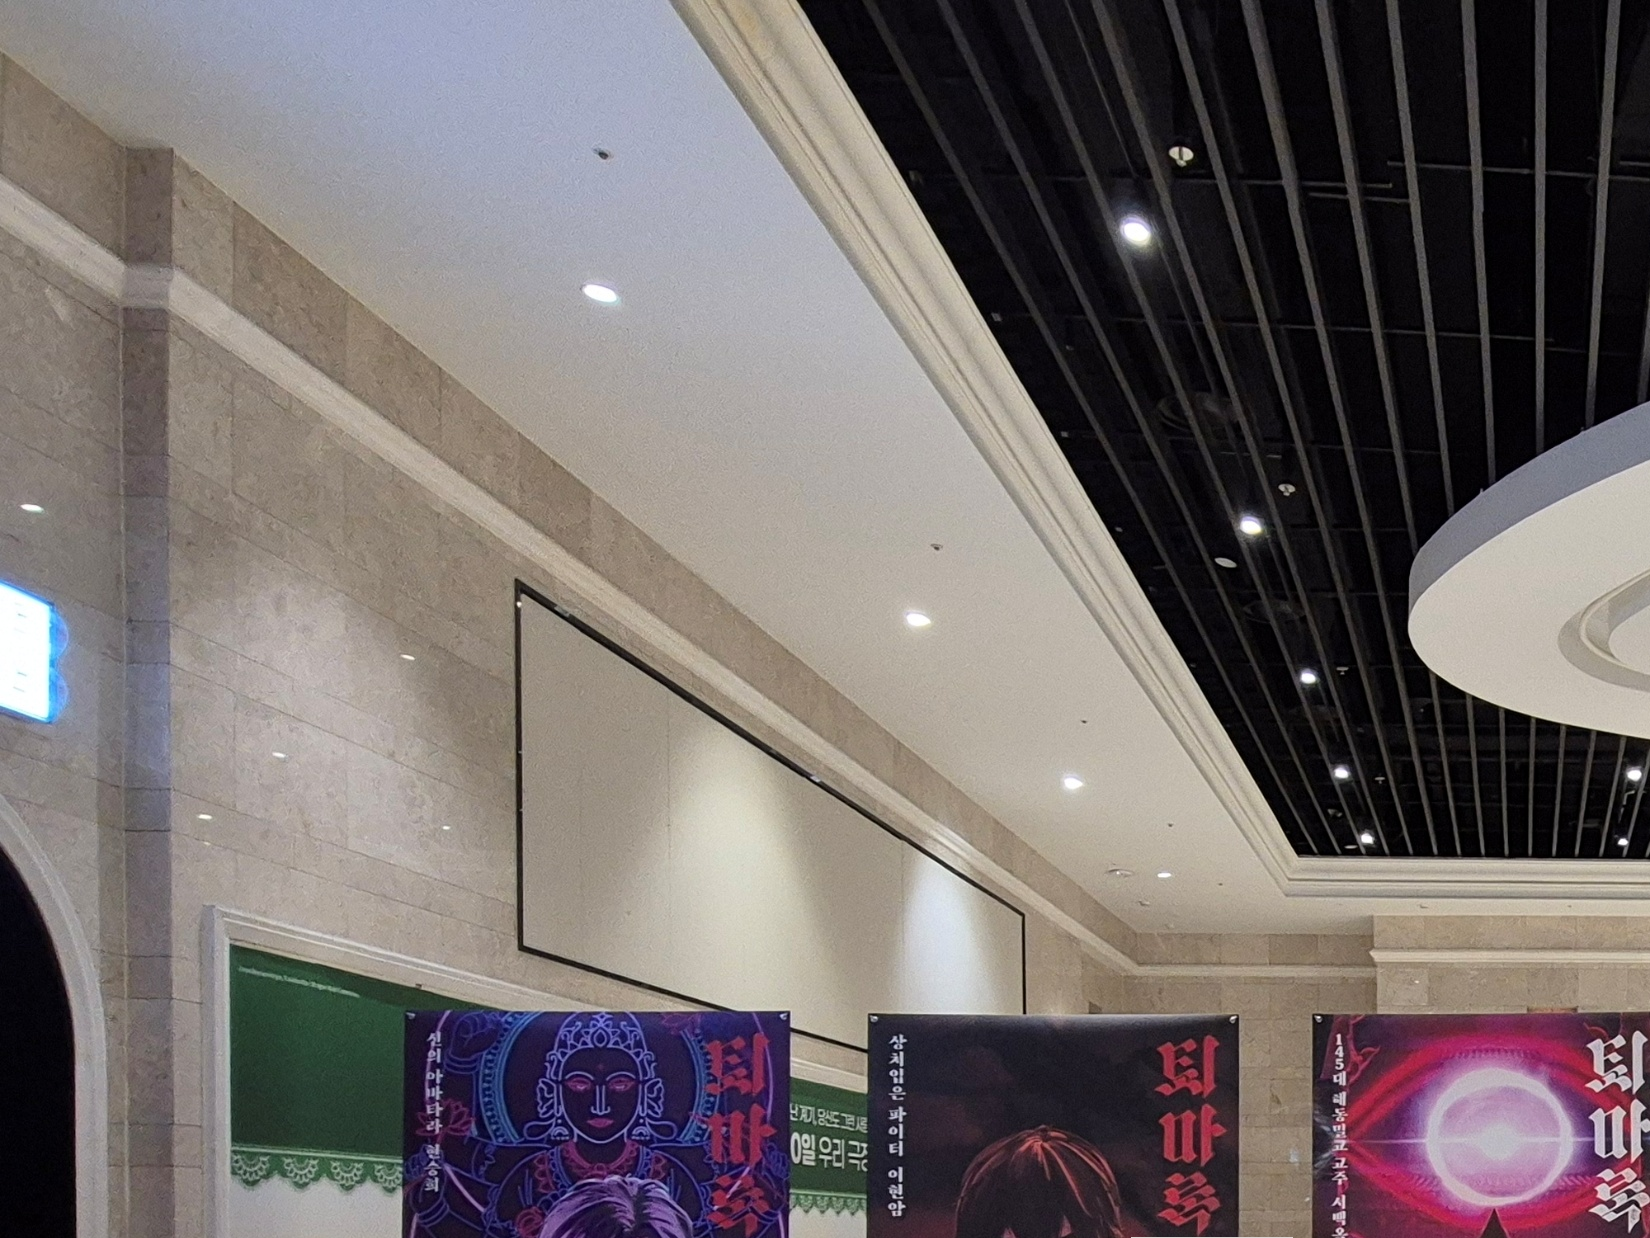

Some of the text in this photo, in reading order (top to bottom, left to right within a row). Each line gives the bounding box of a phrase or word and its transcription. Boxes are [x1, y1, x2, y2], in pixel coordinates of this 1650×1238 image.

[1332, 1033, 1347, 1087] 145대
[424, 1030, 444, 1192] 신의 아바타라 현승희
[704, 1032, 777, 1238] 퇴마록
[887, 1106, 908, 1157] 파이터
[1154, 1034, 1228, 1237] 퇴마록
[1331, 1091, 1348, 1152] 해동밀교
[818, 1136, 845, 1169] 우리
[1331, 1157, 1348, 1186] 교주
[887, 1166, 907, 1217] 이현암
